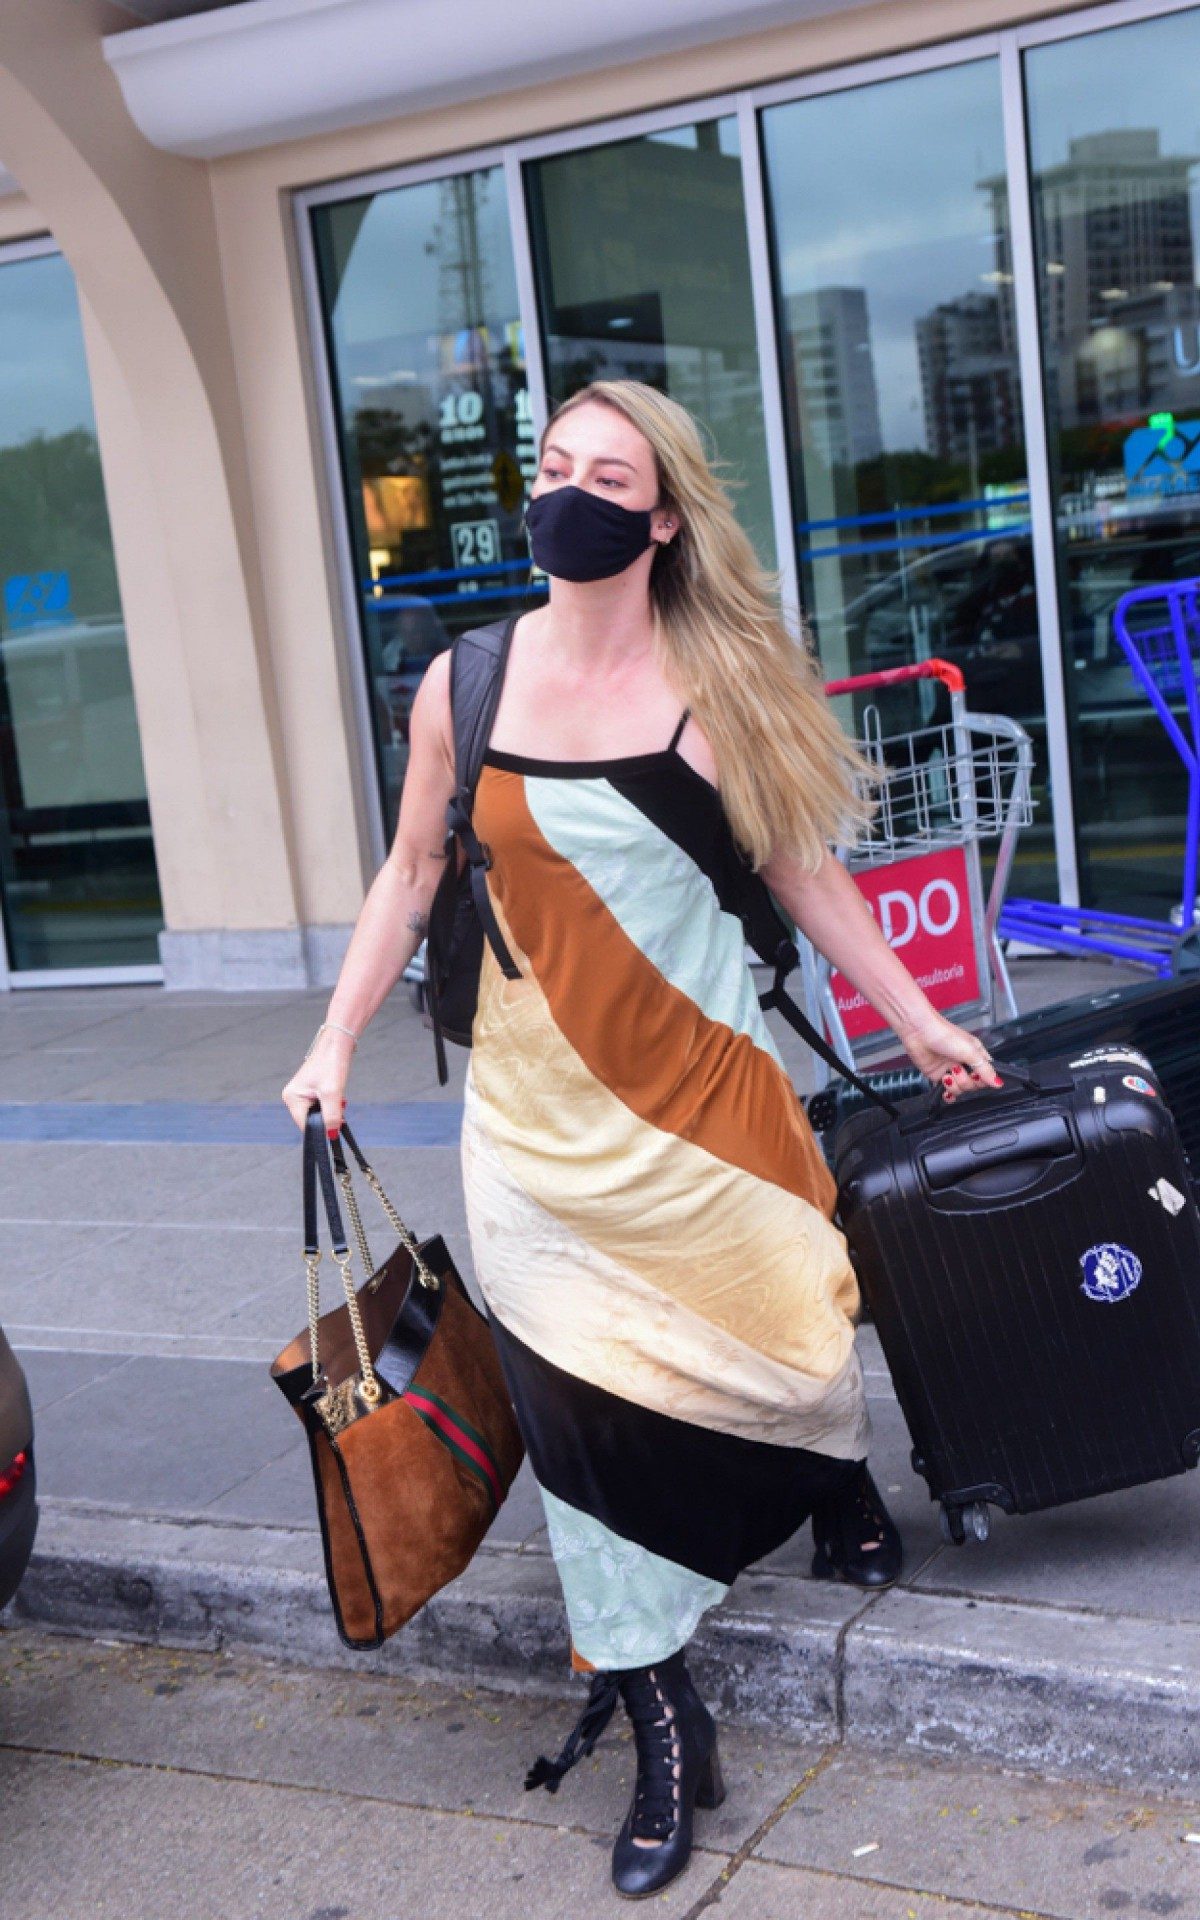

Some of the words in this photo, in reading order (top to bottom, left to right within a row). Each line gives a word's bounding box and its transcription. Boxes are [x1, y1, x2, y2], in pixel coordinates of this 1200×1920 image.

[440, 391, 483, 427] 10
[457, 526, 494, 565] 29
[866, 878, 960, 948] DO
